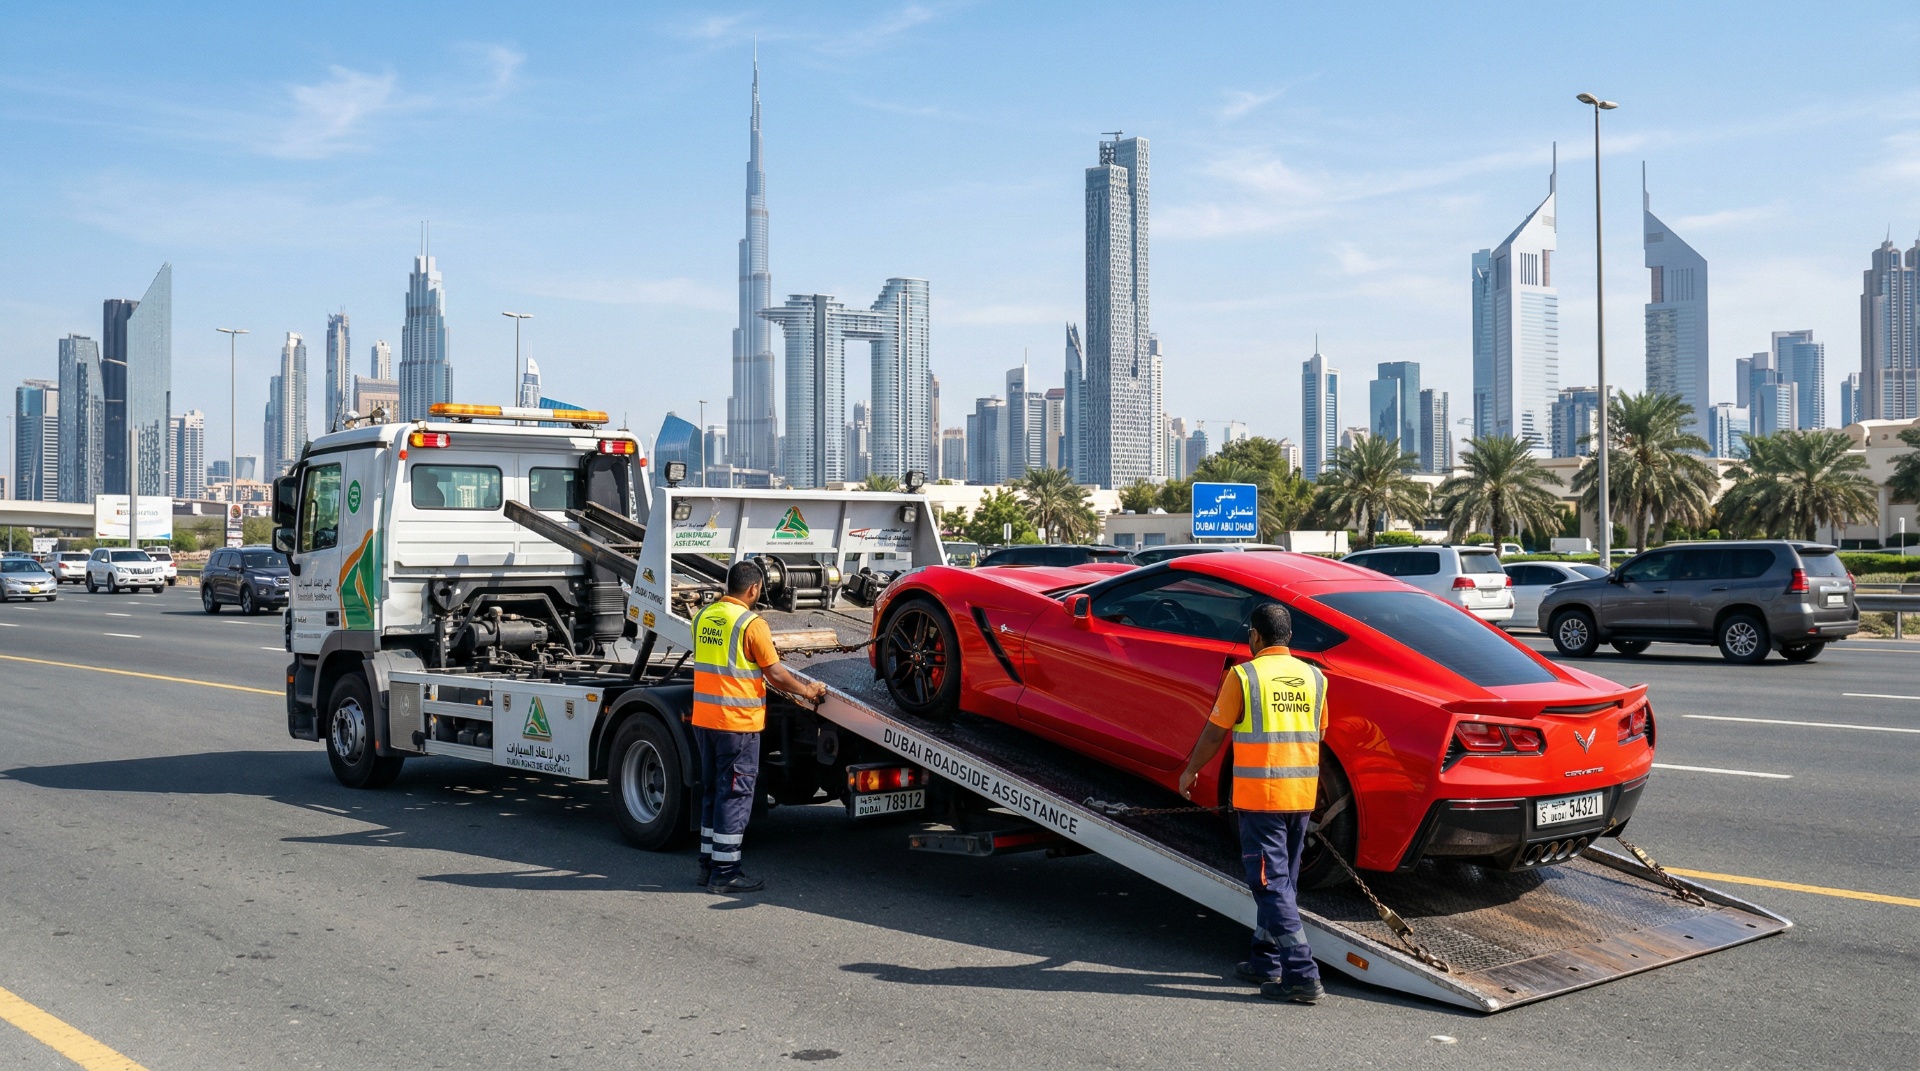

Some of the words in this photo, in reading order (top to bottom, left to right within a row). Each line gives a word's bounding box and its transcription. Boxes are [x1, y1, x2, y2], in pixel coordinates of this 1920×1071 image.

[1195, 521, 1216, 531] DUBAI
[1220, 522, 1234, 532] ABU
[1235, 522, 1255, 532] DHABI
[702, 626, 722, 637] DUBAI
[1273, 691, 1306, 702] DUBAI
[1271, 703, 1311, 713] TOWING
[884, 728, 922, 759] DUBAI
[924, 747, 990, 792] ROADSIDE
[992, 781, 1079, 835] ASSISTANCE
[859, 805, 881, 815] DUBAI
[885, 791, 922, 811] 78912
[1541, 811, 1547, 823] S
[1569, 796, 1598, 818] 54321
